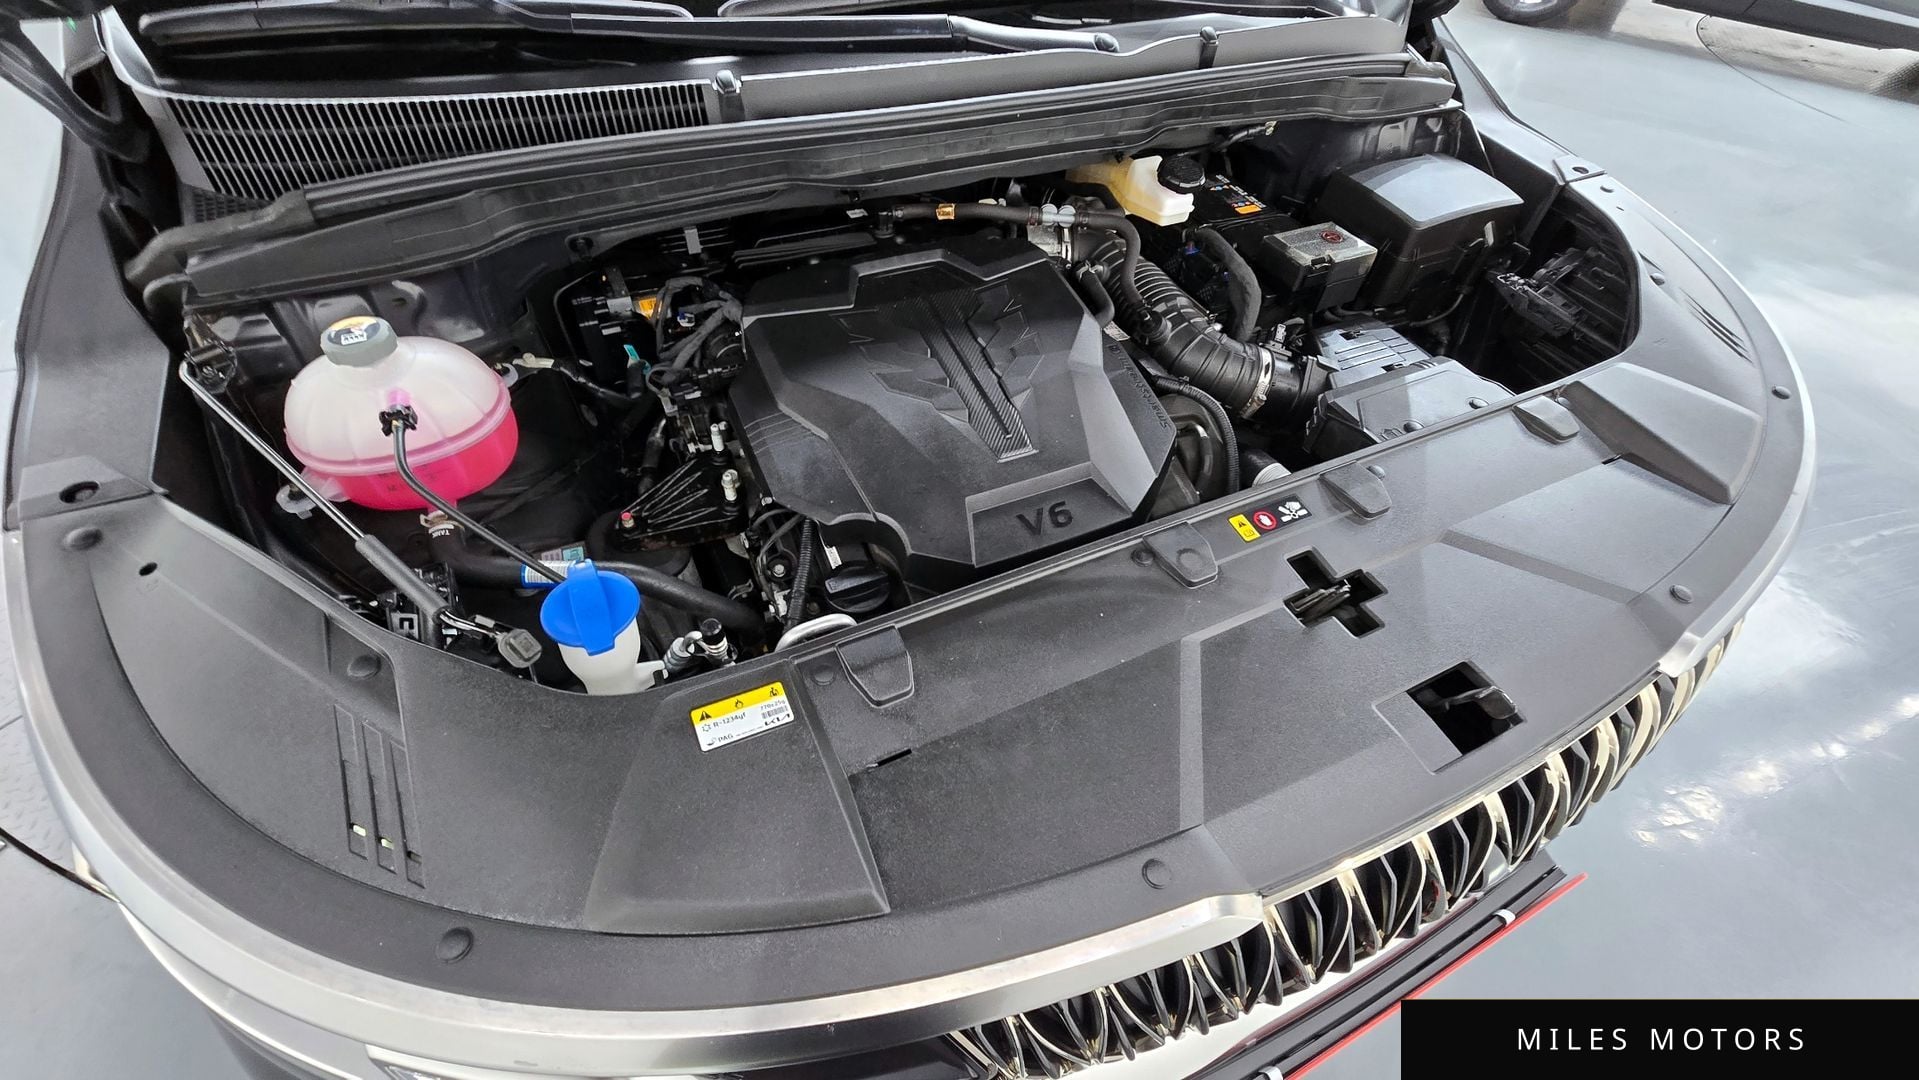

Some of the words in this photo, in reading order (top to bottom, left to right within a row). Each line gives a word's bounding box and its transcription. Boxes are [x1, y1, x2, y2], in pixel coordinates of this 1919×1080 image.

[1016, 500, 1073, 536] V6
[713, 712, 746, 728] R-1234yf
[764, 713, 790, 726] KIA
[718, 733, 734, 743] PAG
